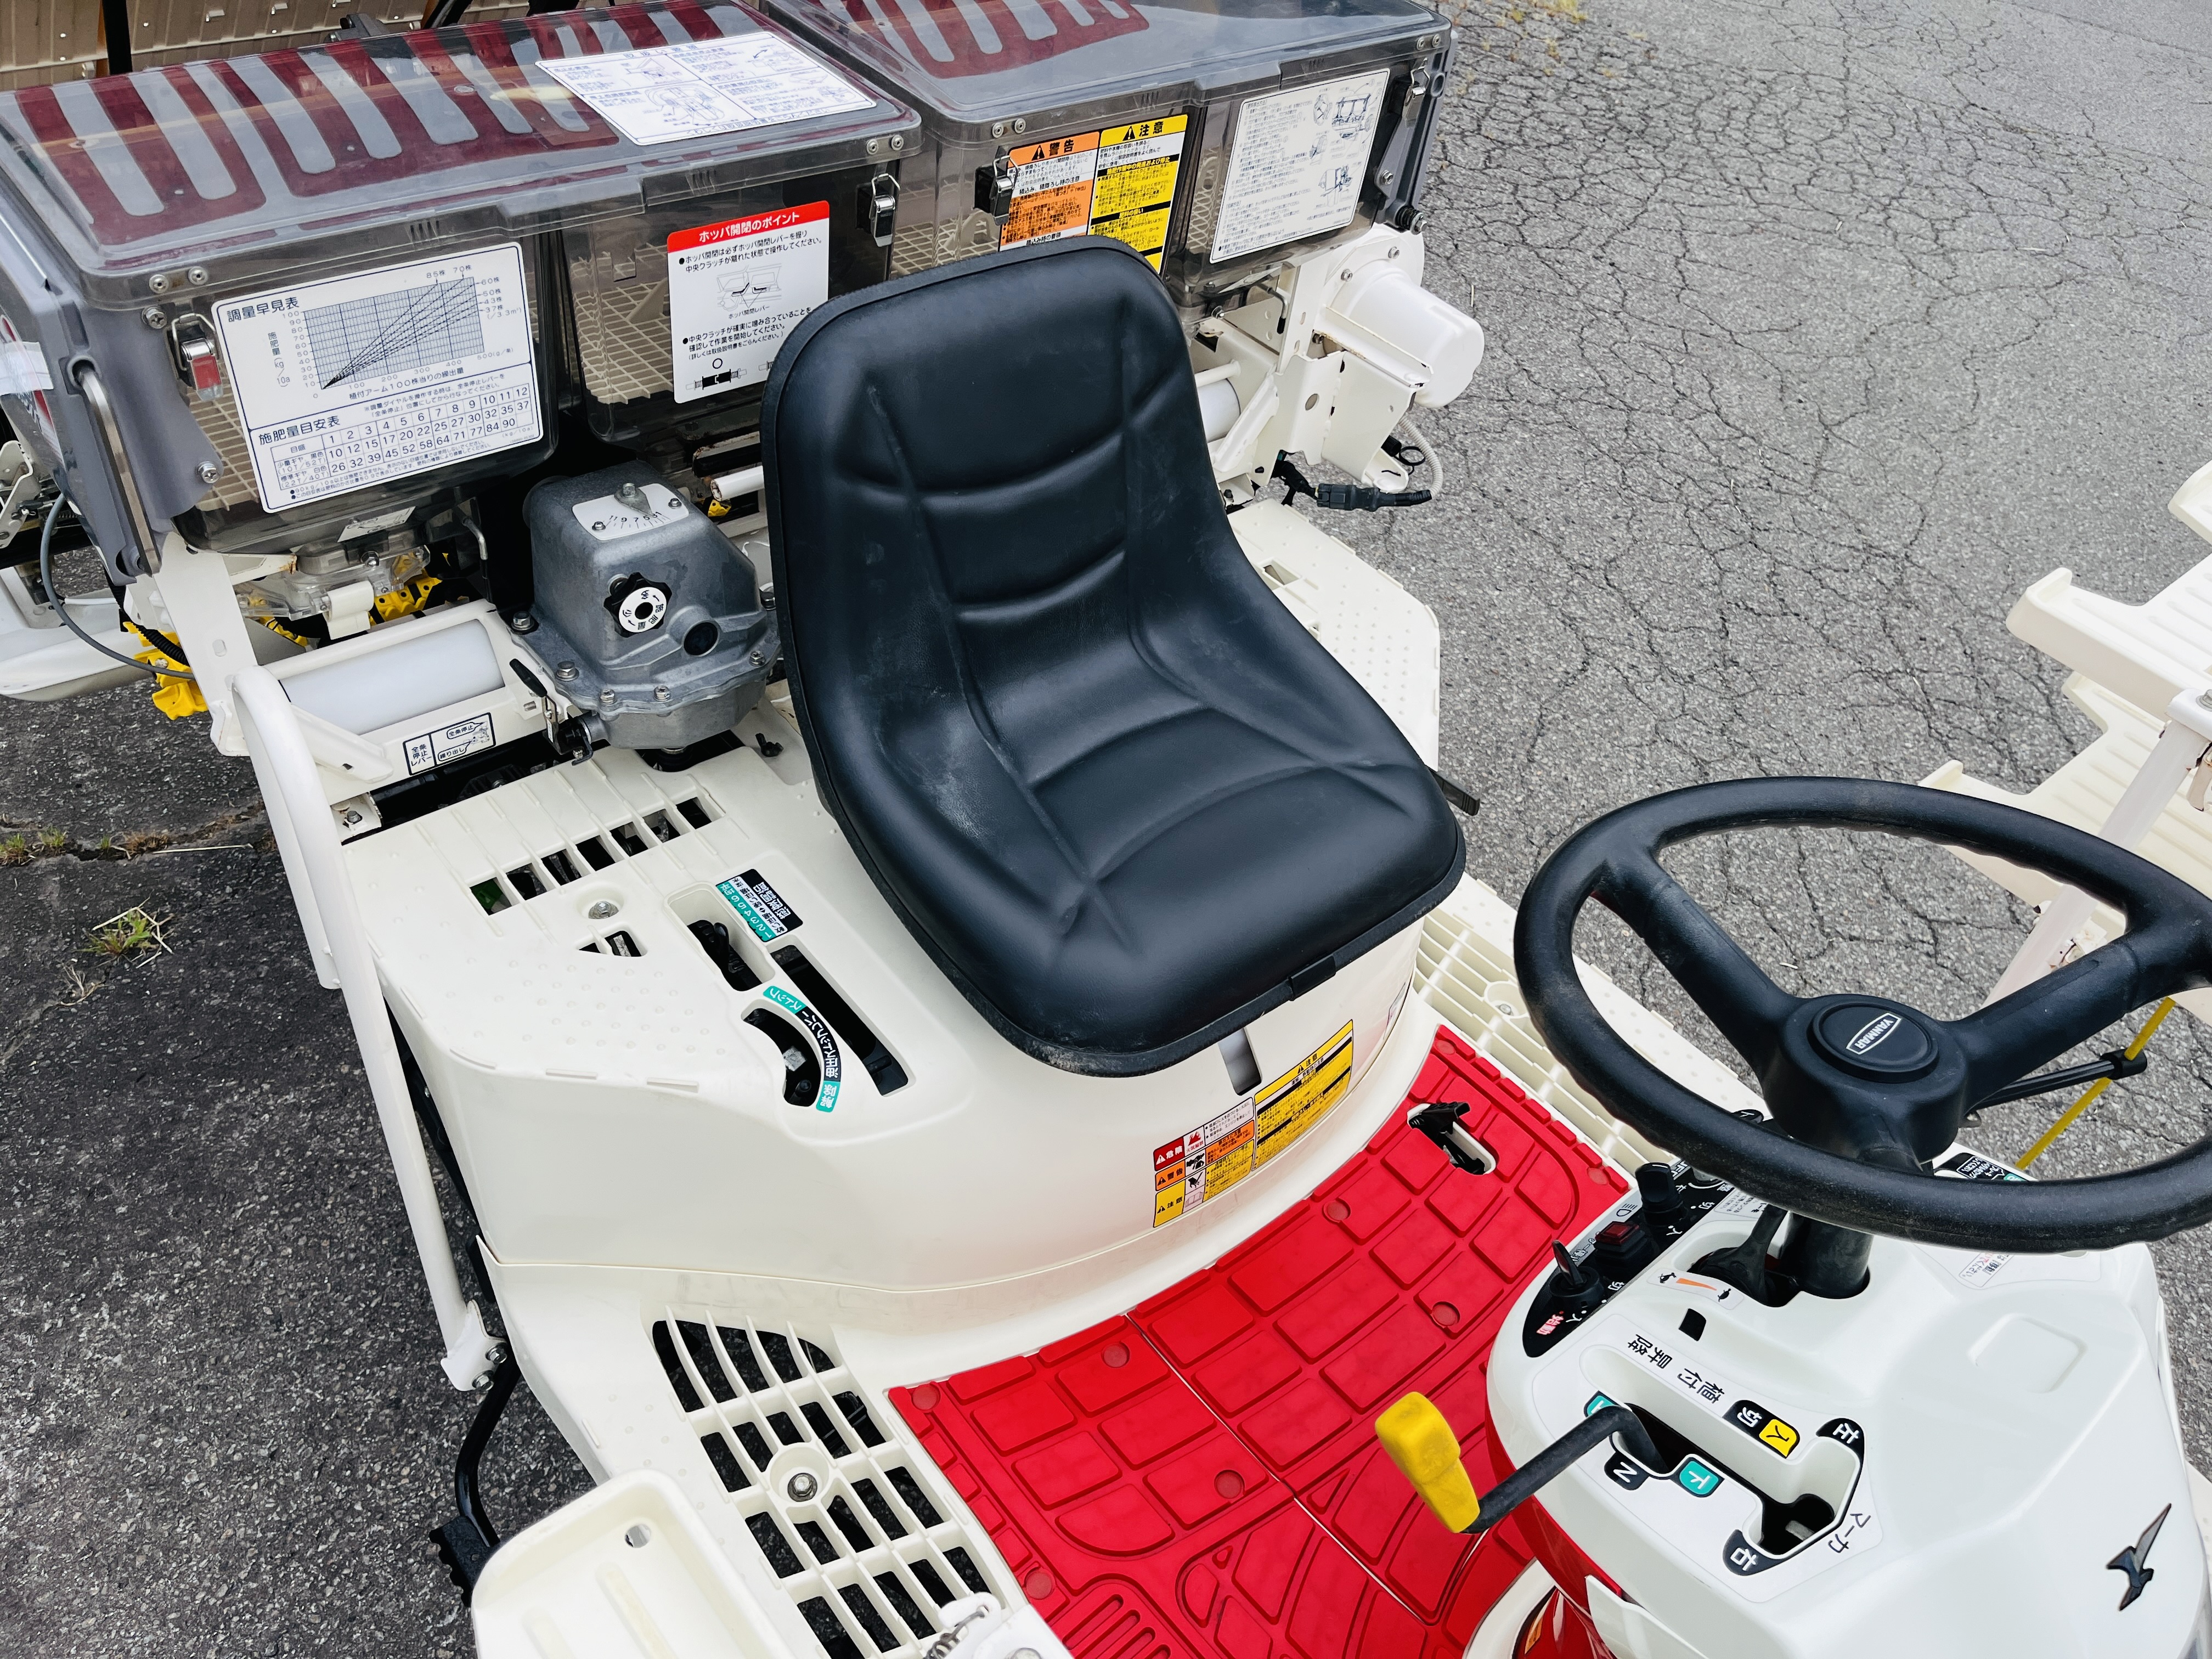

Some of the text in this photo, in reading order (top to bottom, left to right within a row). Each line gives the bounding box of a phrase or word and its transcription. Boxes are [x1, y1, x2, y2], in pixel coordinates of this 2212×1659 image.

[1139, 121, 1164, 137] 注意
[1048, 138, 1074, 156] 警告
[699, 212, 800, 242] ホッパ開閉のポイント
[686, 230, 808, 263] ホッパ開閉は必ずホッパ開閉レバーを握り
[686, 238, 822, 273] 中央クラッチが離れた状態で操作してください。
[426, 264, 472, 279] 85株 70株
[481, 276, 500, 285] 60株
[482, 288, 501, 297] 50株
[484, 296, 502, 305] 43株
[225, 296, 300, 322] 調量早見表
[283, 311, 300, 319] 100
[485, 304, 503, 313] 37株
[729, 306, 770, 319] ホッパ開閉レバー
[689, 324, 785, 352] 確認して作業を開始してください。
[348, 381, 365, 390] 100
[381, 374, 398, 382] 200
[414, 366, 430, 375] 300
[445, 359, 461, 367] 400
[349, 366, 464, 400] 植付アーム100株当りの繰出量
[257, 415, 341, 445] 施肥量目安表
[290, 387, 527, 453] 目盛 1 2 3 4 5 6 7 8 9 10 11 12
[329, 448, 342, 459] 10
[347, 443, 360, 454] 12
[365, 439, 378, 449] 15
[383, 435, 396, 444] 17
[399, 430, 413, 441] 20
[416, 425, 430, 436] 22
[433, 421, 447, 432] 25
[450, 417, 464, 427] 27
[467, 413, 481, 423] 30
[484, 409, 497, 419] 32
[500, 404, 514, 415] 35
[517, 400, 529, 410] 37
[331, 462, 346, 473] 26
[349, 458, 363, 468] 32
[367, 453, 381, 463] 39
[384, 448, 398, 459] 45
[402, 444, 415, 454] 52
[419, 439, 433, 450] 58
[436, 435, 449, 445] 64
[454, 431, 465, 441] 71
[470, 426, 483, 436] 77
[486, 422, 499, 432] 84
[503, 418, 515, 428] 90
[449, 725, 474, 737] 全条停止
[412, 744, 427, 754] 全条
[413, 751, 428, 759] 停止
[411, 756, 432, 766] レバー
[753, 881, 791, 919] 感度調節
[769, 988, 802, 1011] ストップ
[1854, 1019, 1894, 1049] YANMAR
[802, 1011, 838, 1079] 油圧ストップレバー
[1306, 1054, 1318, 1068] 注意
[819, 1084, 837, 1109] 解除
[1166, 1146, 1183, 1159] 危険
[1167, 1167, 1183, 1181] 警告
[1167, 1197, 1183, 1209] 注意
[1607, 1281, 1624, 1292] 切
[1537, 1313, 1564, 1336] 始動
[1565, 1313, 1583, 1323] 入
[1627, 1333, 1725, 1405] 植付 昇降
[1737, 1407, 1762, 1427] 切
[1766, 1425, 1789, 1442] 入
[1832, 1422, 1859, 1444] 左
[1612, 1459, 1637, 1483] N
[1687, 1469, 1712, 1489] 下
[1827, 1511, 1872, 1554] マーカ
[1729, 1547, 1758, 1571] 右
